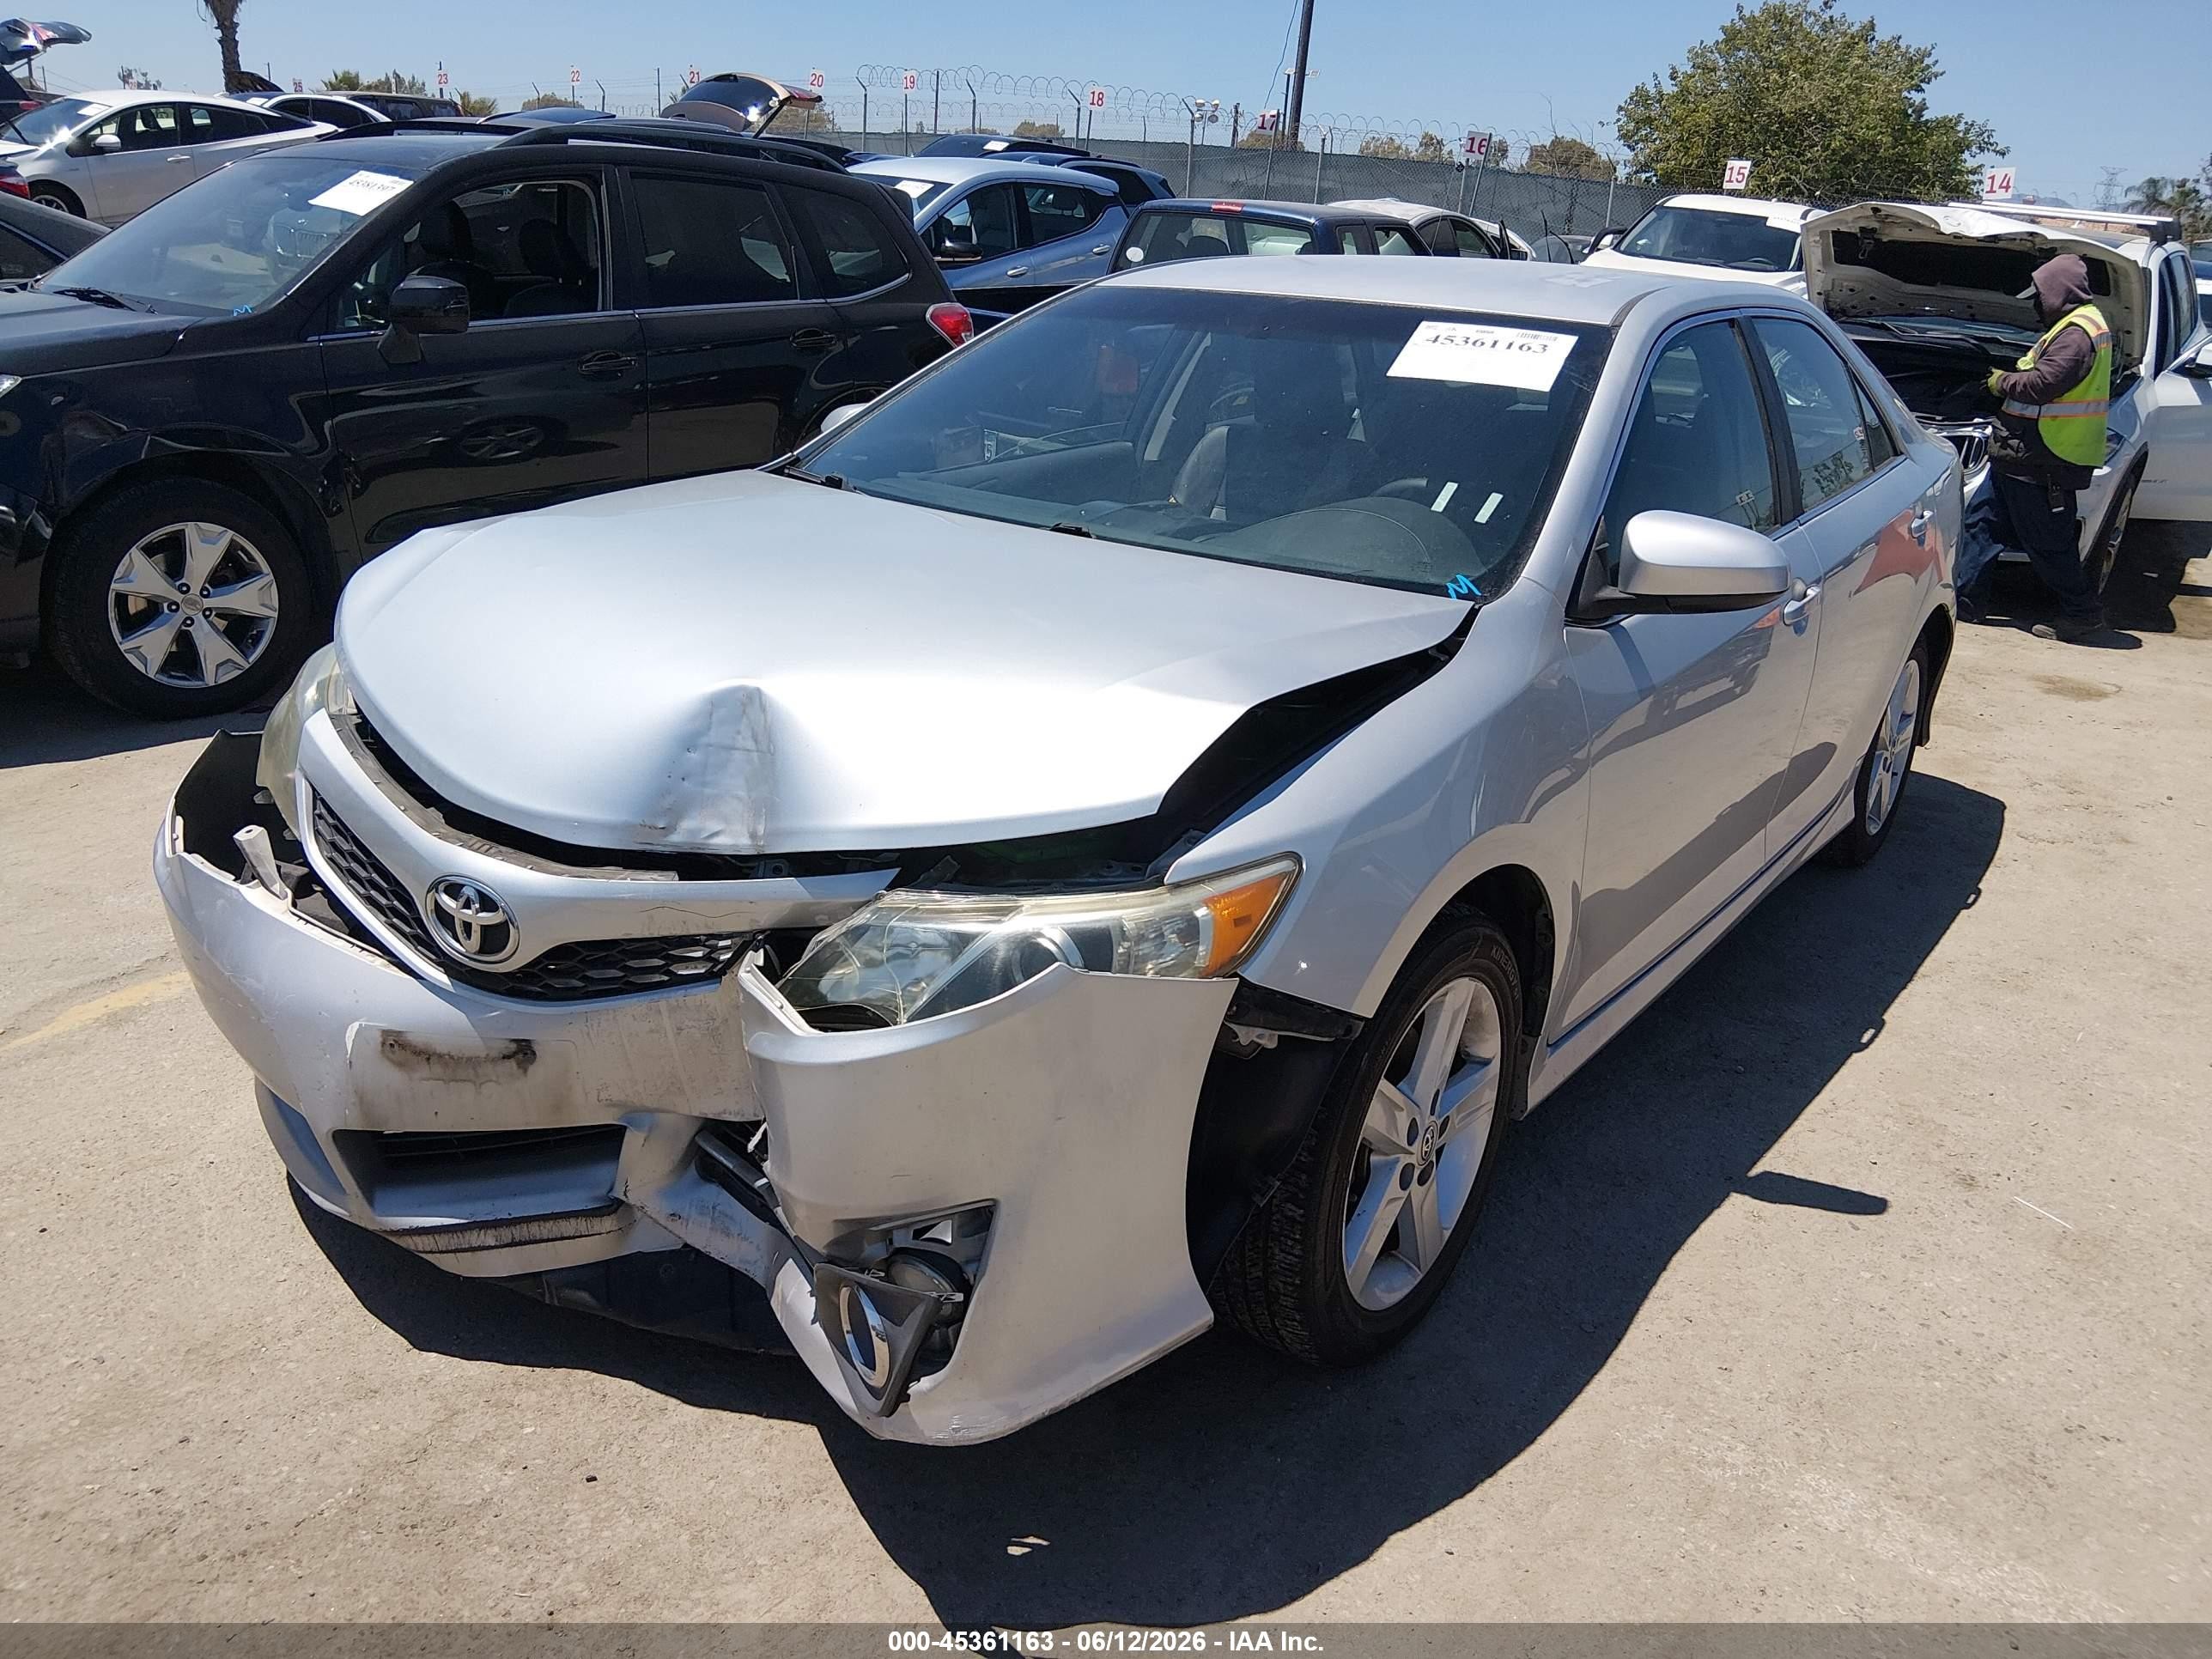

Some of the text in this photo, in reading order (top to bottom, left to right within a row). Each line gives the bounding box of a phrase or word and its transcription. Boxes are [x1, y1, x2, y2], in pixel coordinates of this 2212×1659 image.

[438, 73, 448, 84] 23
[570, 70, 580, 82] 22
[690, 70, 700, 84] 21
[810, 73, 824, 88] 20
[903, 75, 915, 90] 19
[293, 82, 303, 93] 25
[1090, 90, 1104, 107] 18
[1258, 113, 1277, 131] 17
[1465, 137, 1488, 155] 16
[1725, 166, 1747, 184] 15
[1985, 173, 2011, 194] 14
[1425, 334, 1549, 355] 45361163
